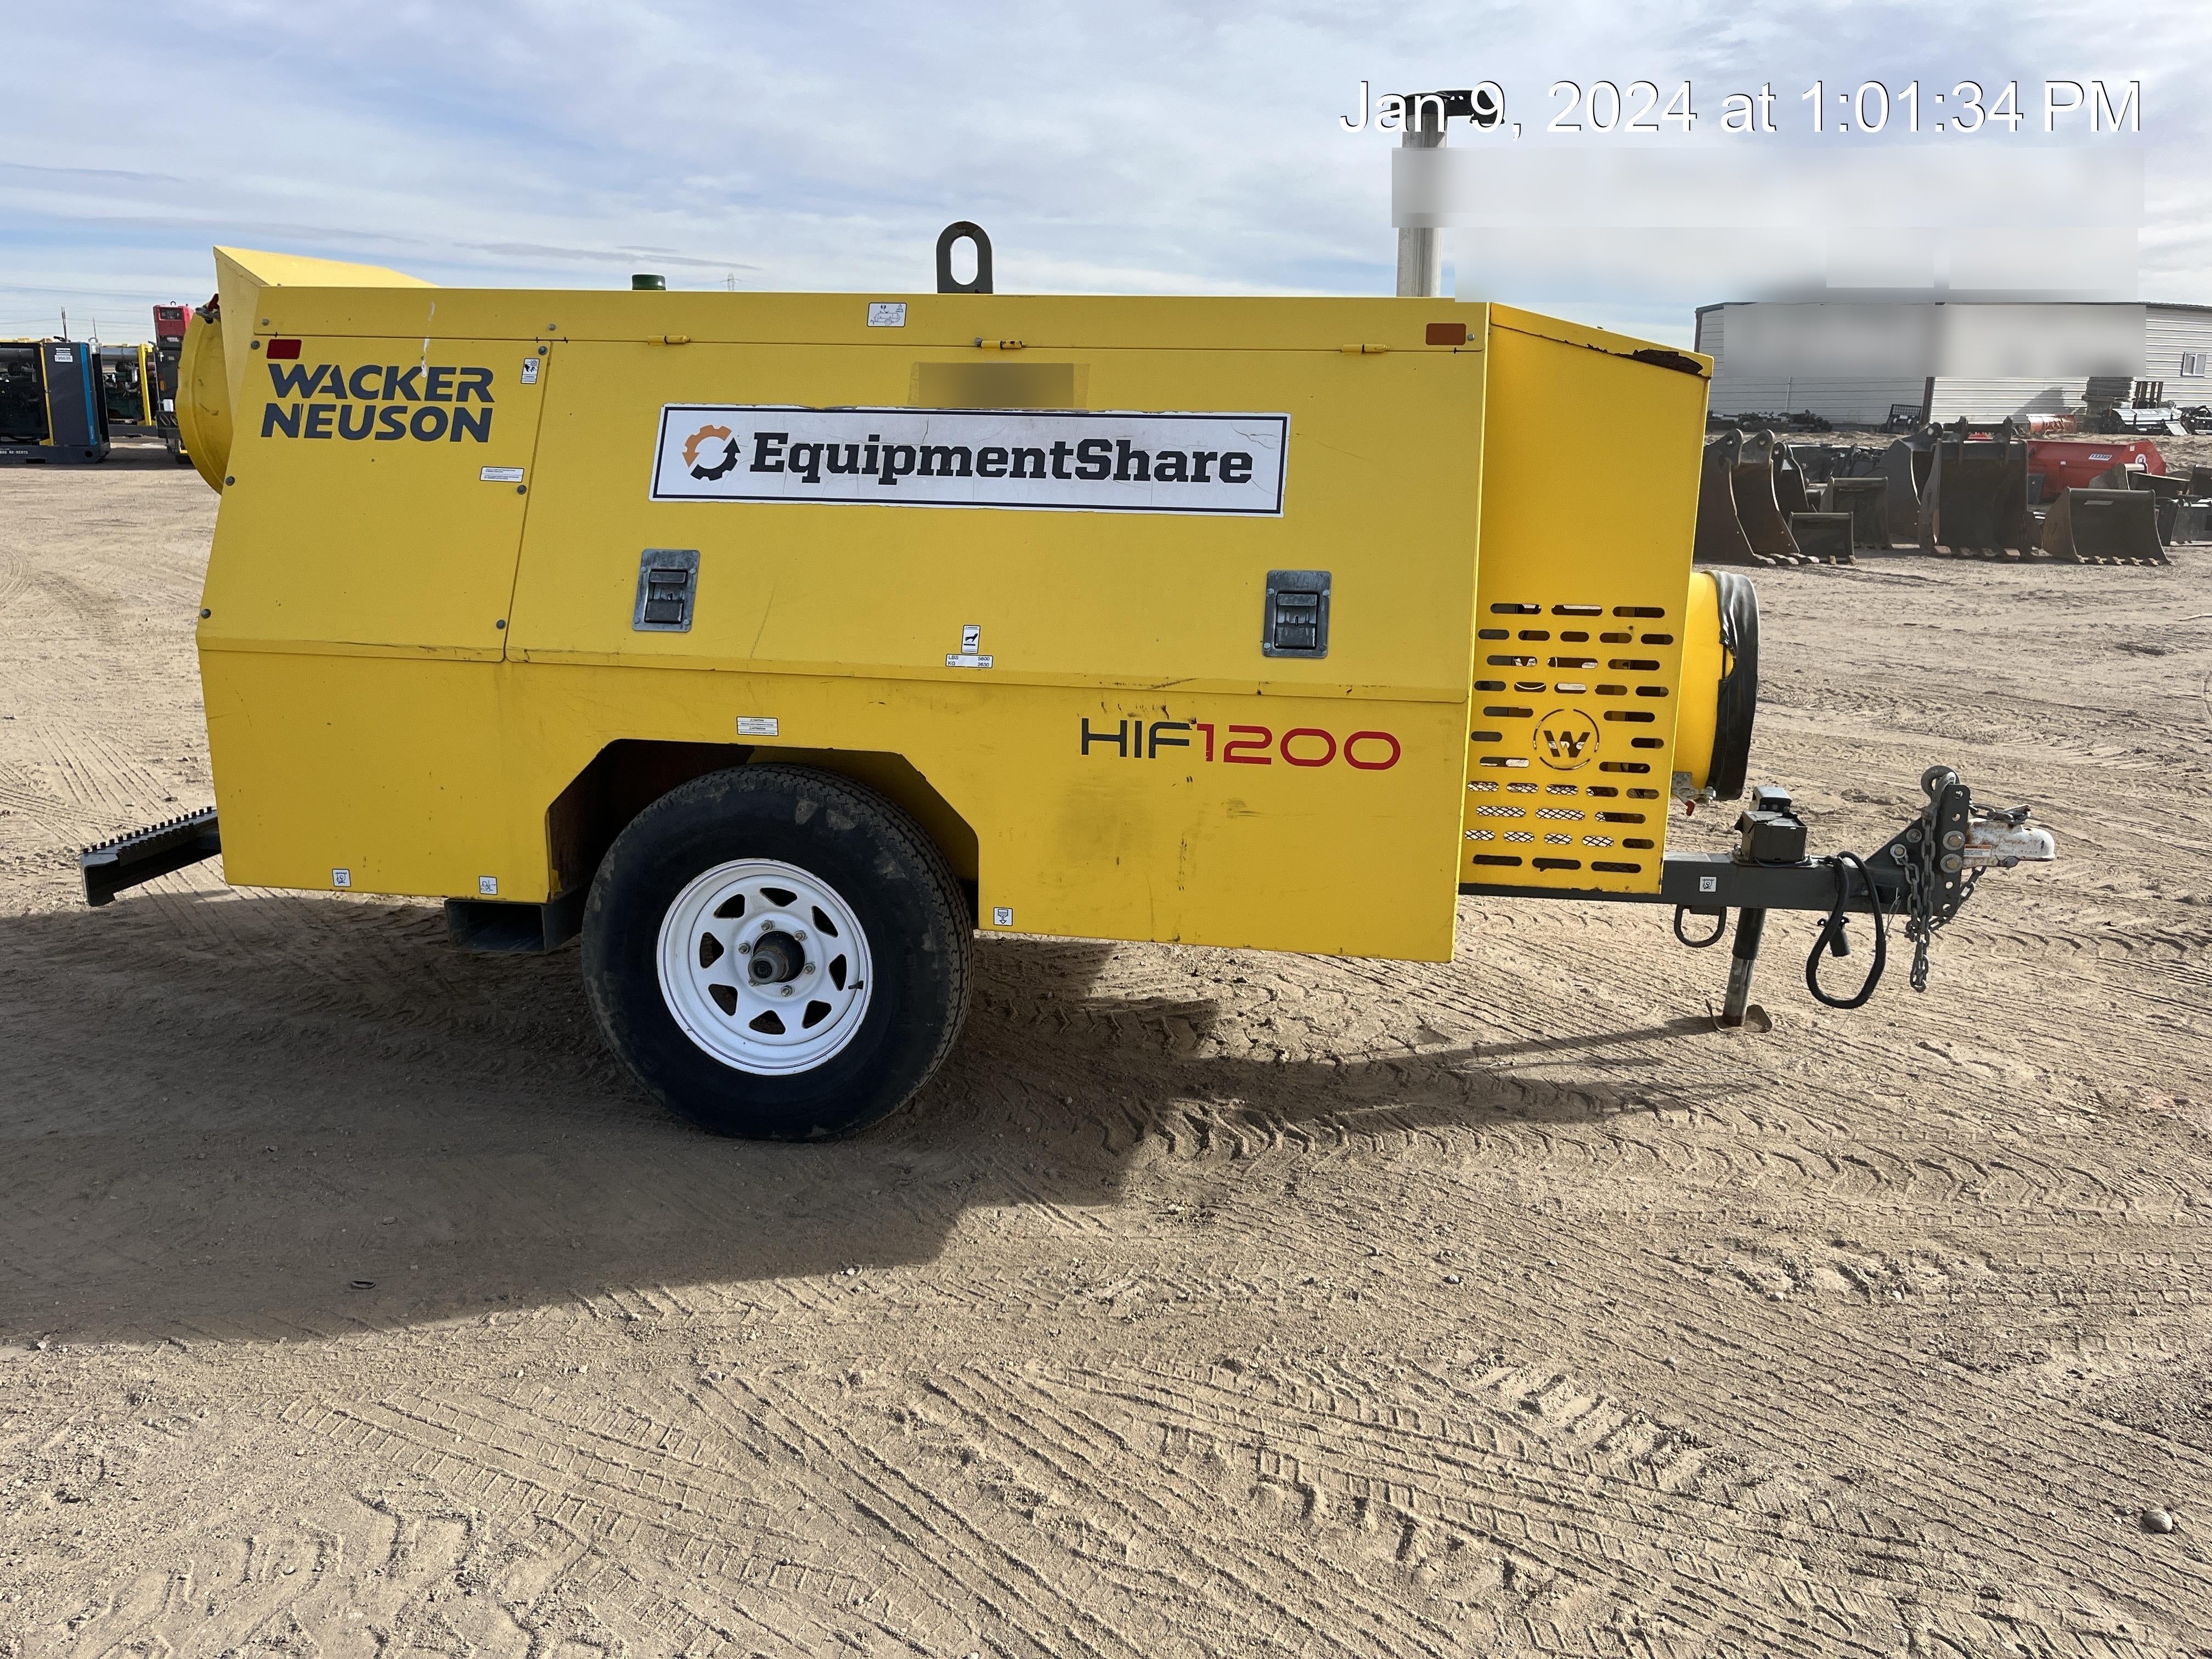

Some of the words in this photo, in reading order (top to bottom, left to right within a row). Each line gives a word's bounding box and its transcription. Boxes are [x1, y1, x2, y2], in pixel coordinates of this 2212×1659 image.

[267, 363, 495, 403] WACKER
[261, 403, 495, 443] NEUSON
[749, 432, 1253, 485] EquipmentShare
[1081, 717, 1401, 770] HIF1200
